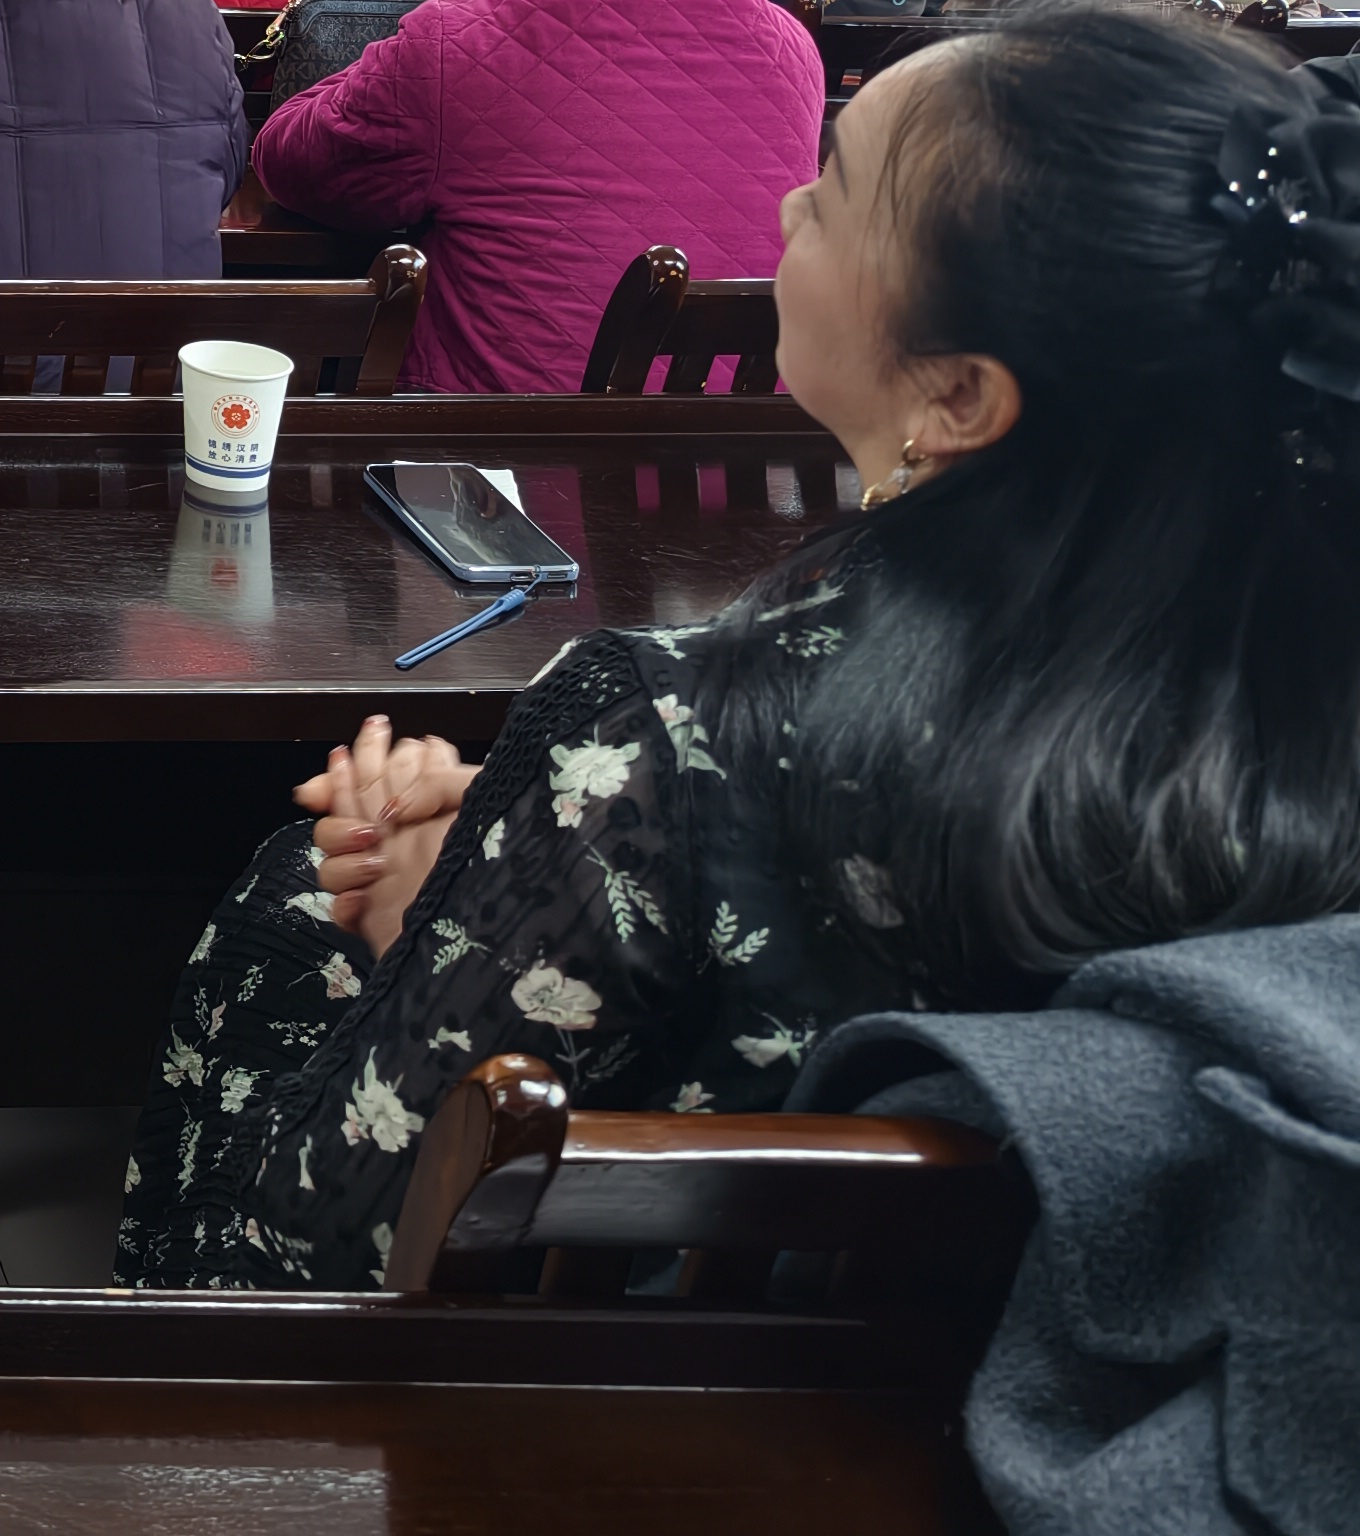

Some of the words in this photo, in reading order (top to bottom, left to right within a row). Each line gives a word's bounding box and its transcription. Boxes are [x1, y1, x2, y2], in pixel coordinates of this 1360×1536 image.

[208, 438, 259, 452] 锦绣汉阴
[208, 450, 257, 463] 放心消费
